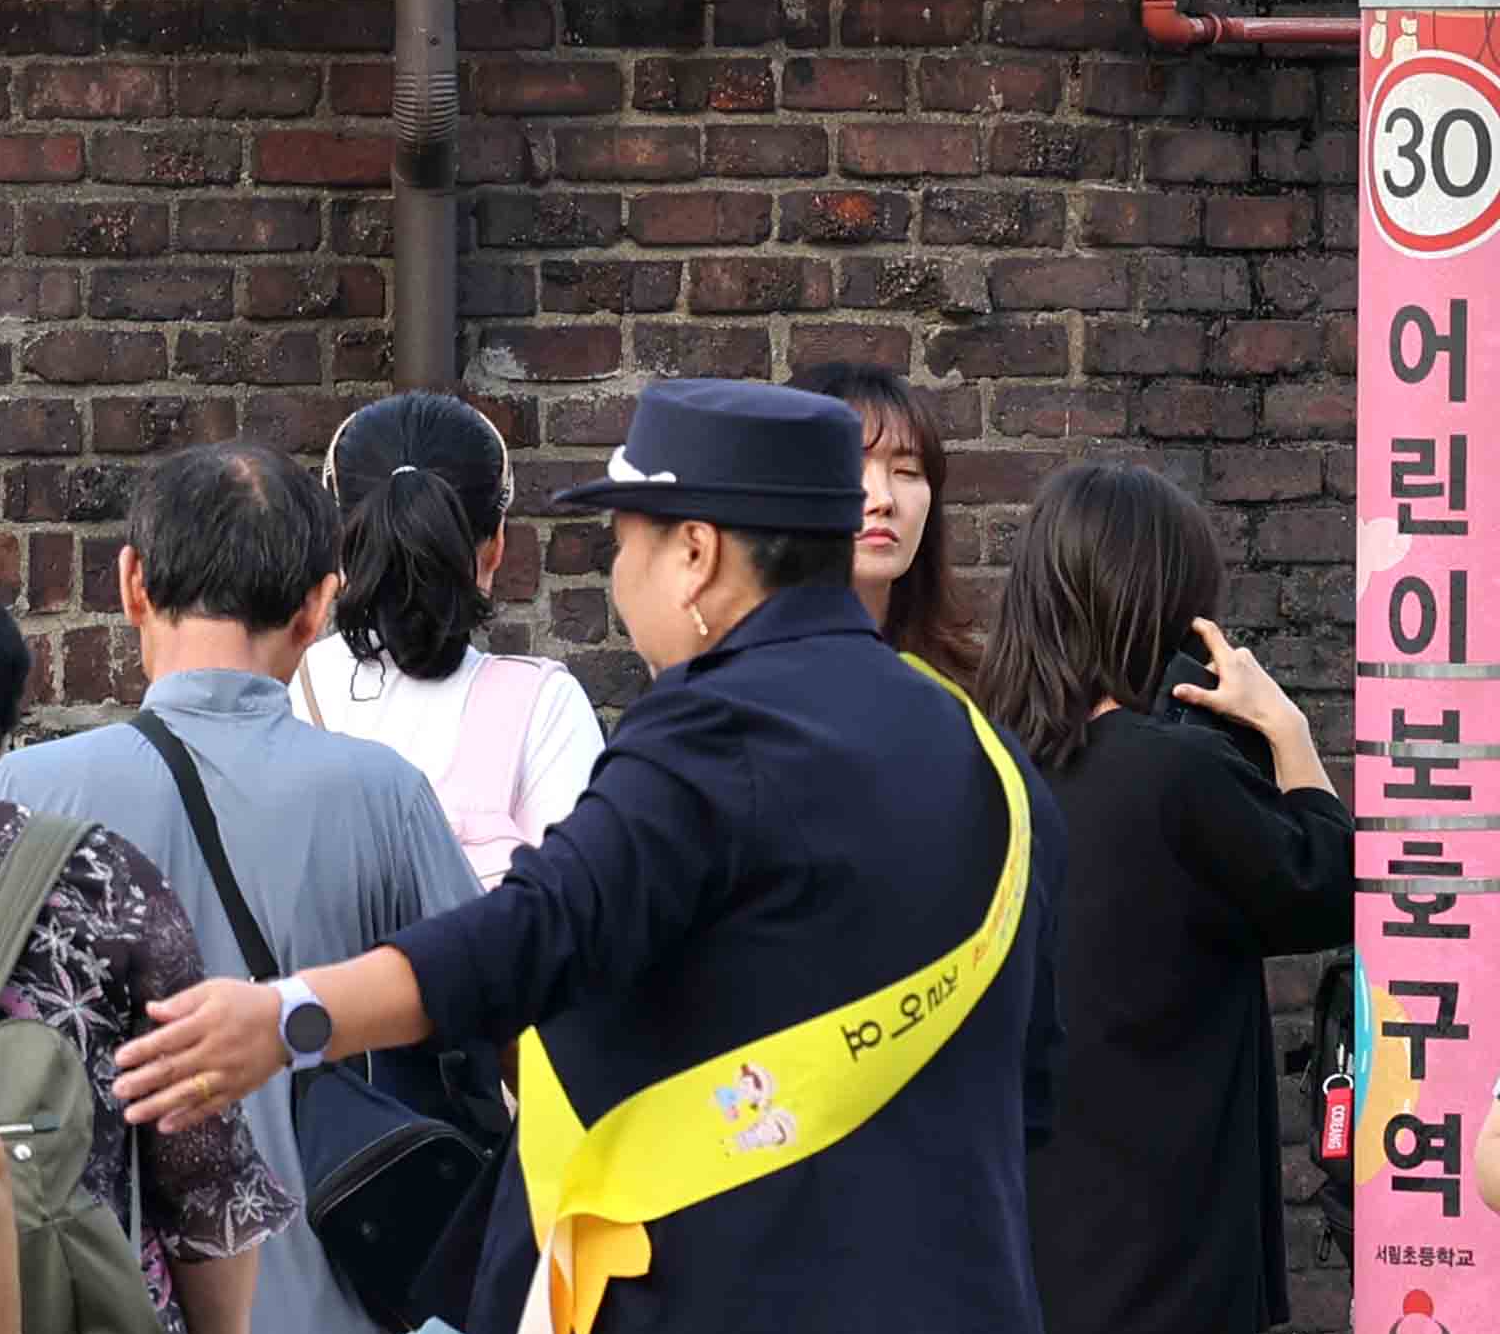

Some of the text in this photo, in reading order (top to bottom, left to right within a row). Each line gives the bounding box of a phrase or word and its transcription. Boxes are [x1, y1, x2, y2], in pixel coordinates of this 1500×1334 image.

[1382, 107, 1492, 199] 30
[1381, 297, 1472, 1218] 어린이보호구역
[1374, 1244, 1476, 1268] 서림초등학교
